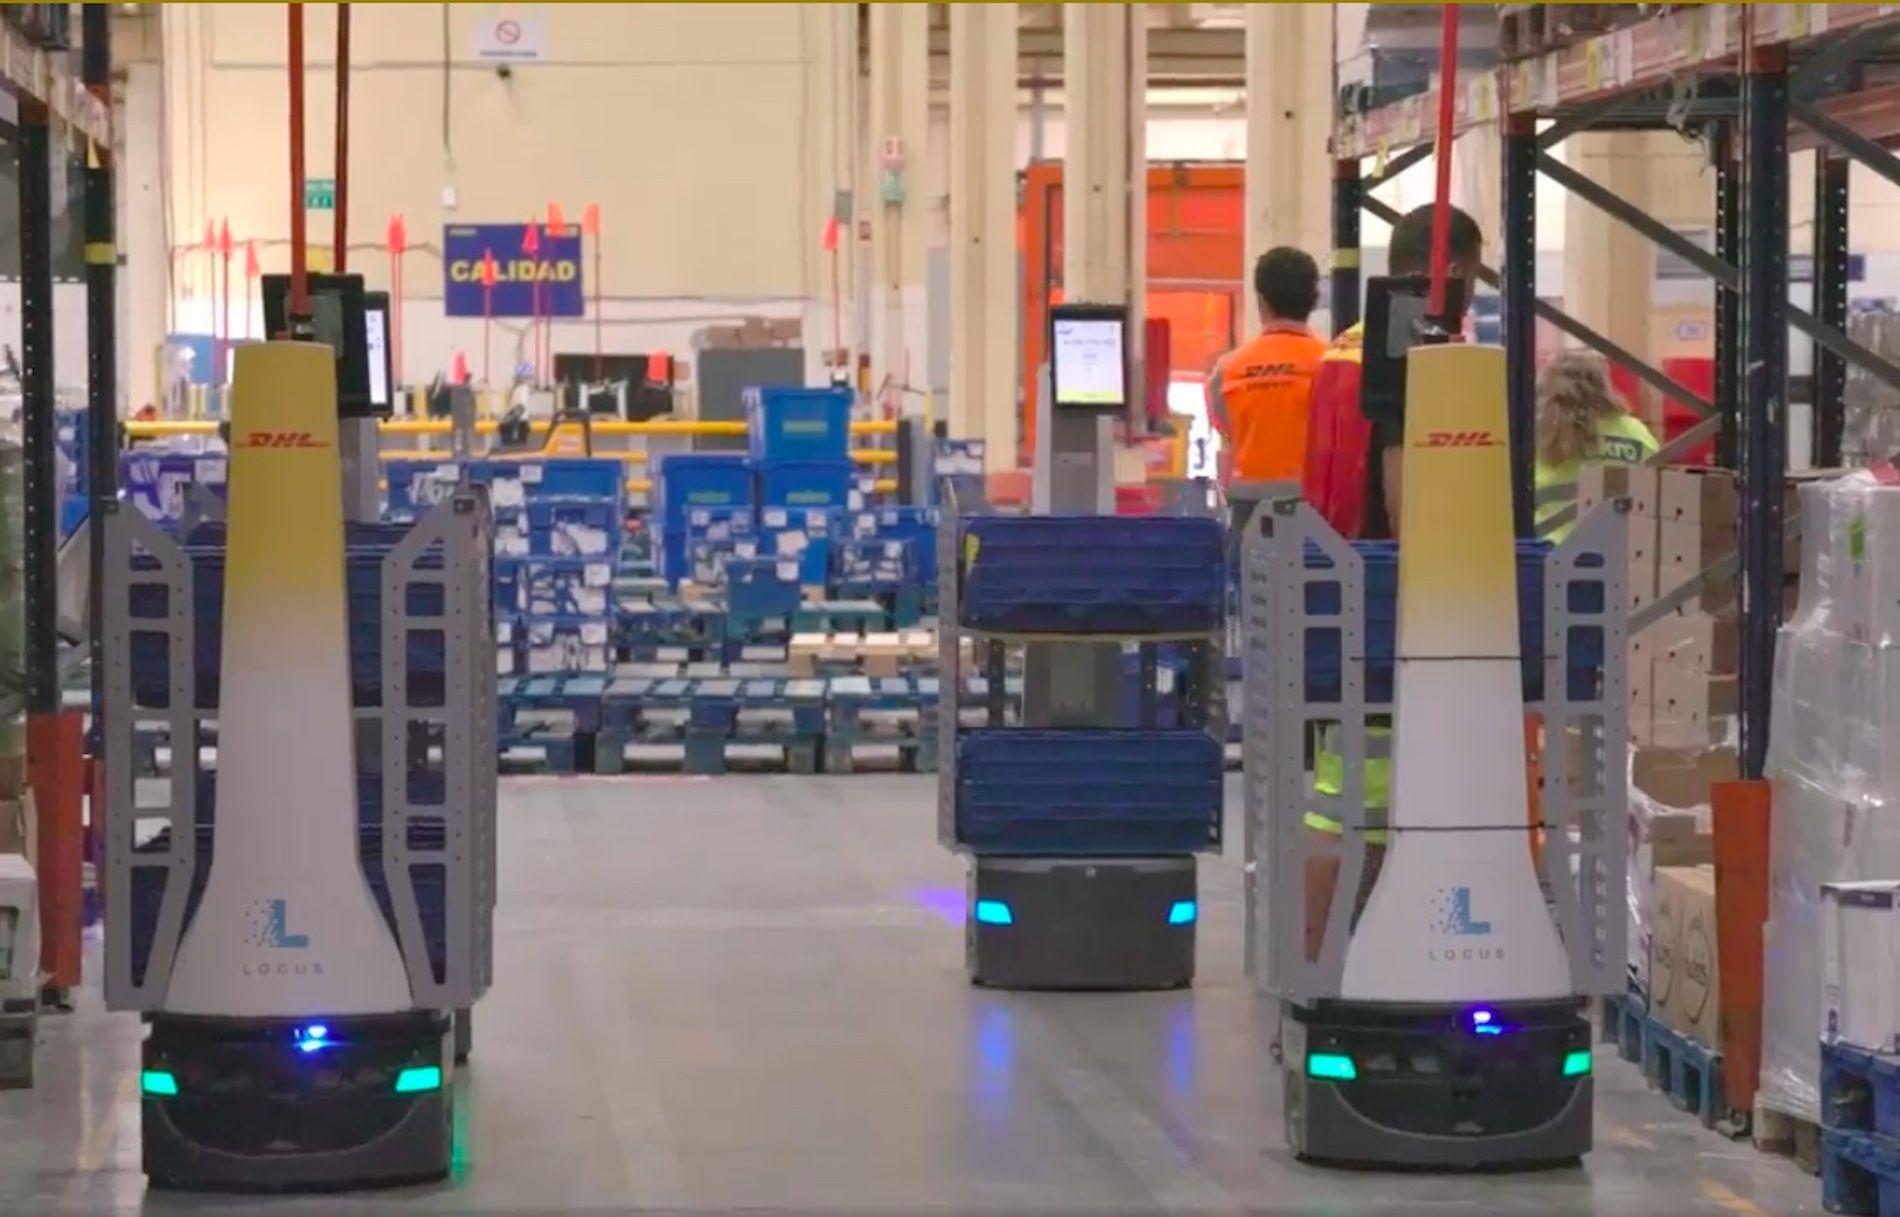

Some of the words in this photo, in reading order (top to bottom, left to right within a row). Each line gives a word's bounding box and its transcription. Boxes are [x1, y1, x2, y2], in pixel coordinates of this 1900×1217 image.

[451, 260, 575, 282] CALIDAD
[247, 432, 314, 448] DHL
[1428, 432, 1494, 448] DHL
[1428, 947, 1505, 962] LOCUS
[242, 962, 323, 976] LOCUS
